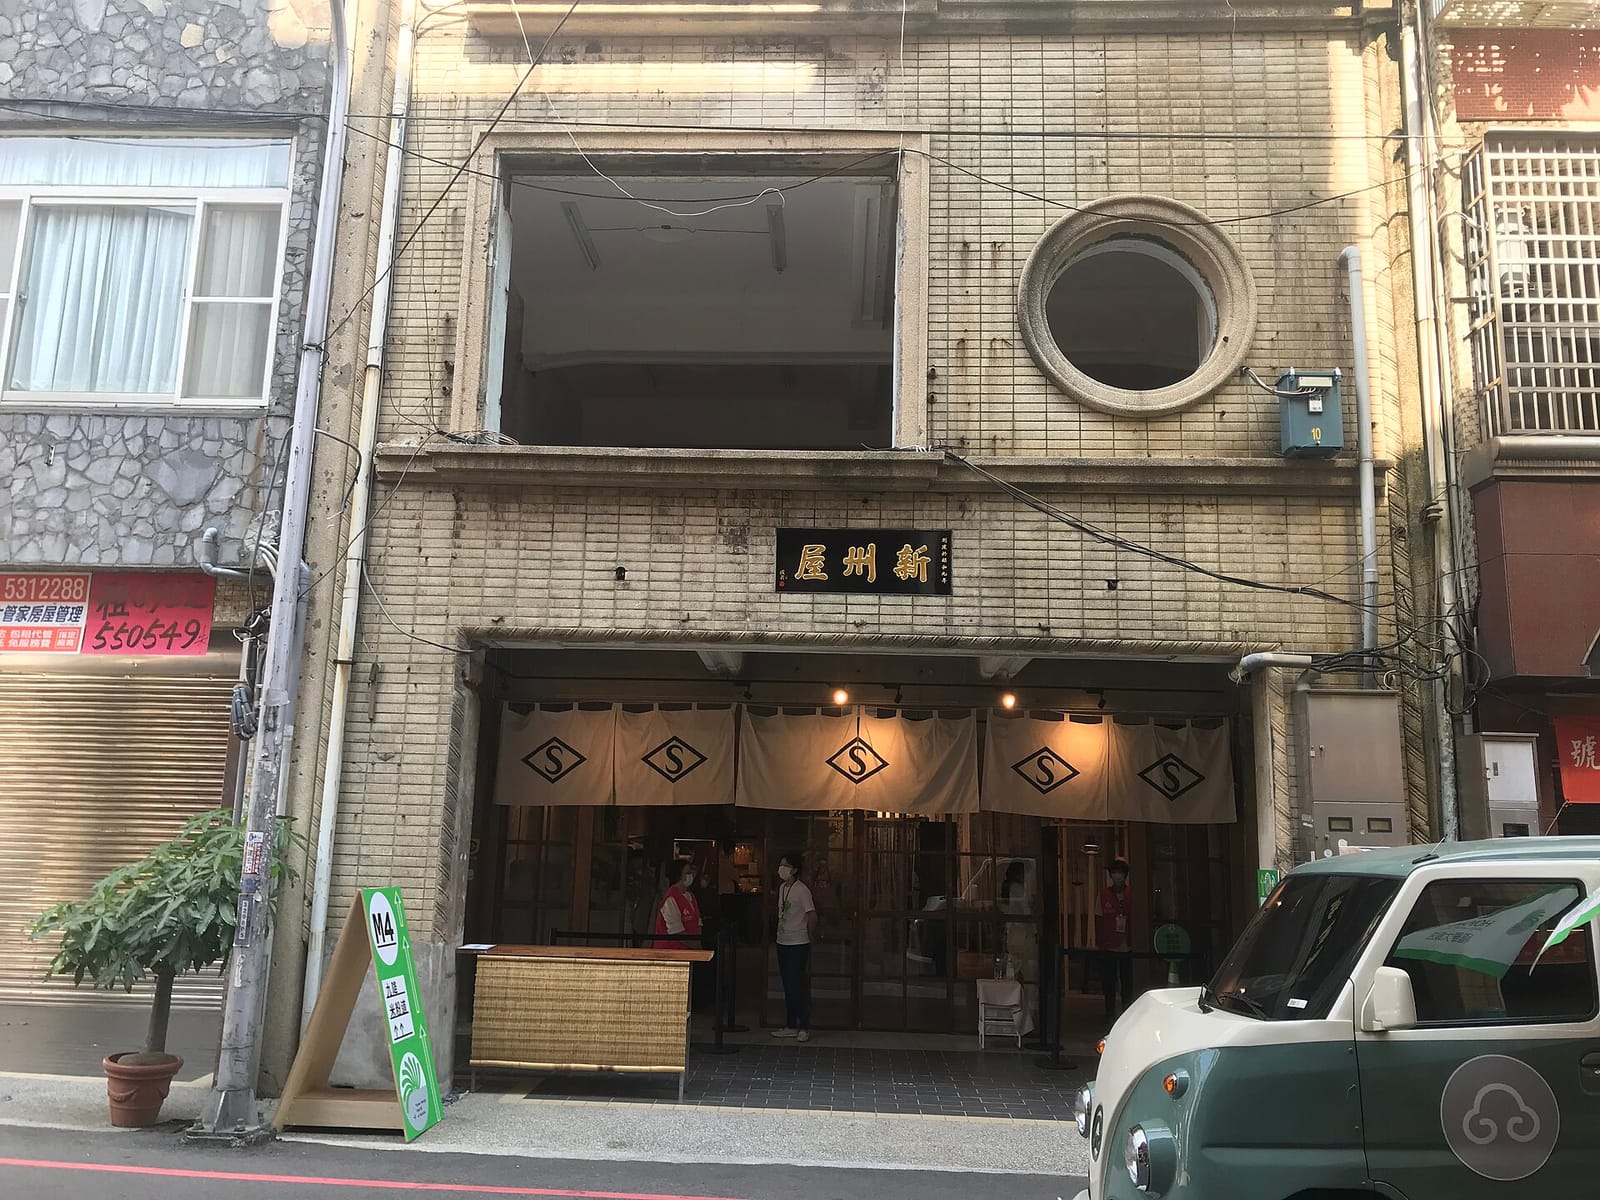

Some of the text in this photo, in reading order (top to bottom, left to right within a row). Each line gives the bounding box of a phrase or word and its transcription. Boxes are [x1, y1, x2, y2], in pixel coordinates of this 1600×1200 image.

[1311, 427, 1321, 441] 10
[794, 543, 932, 583] 新州屋
[4, 577, 85, 600] 5312288
[0, 605, 84, 623] 管家房屋管理
[92, 617, 202, 651] 550549
[371, 910, 396, 946] M4
